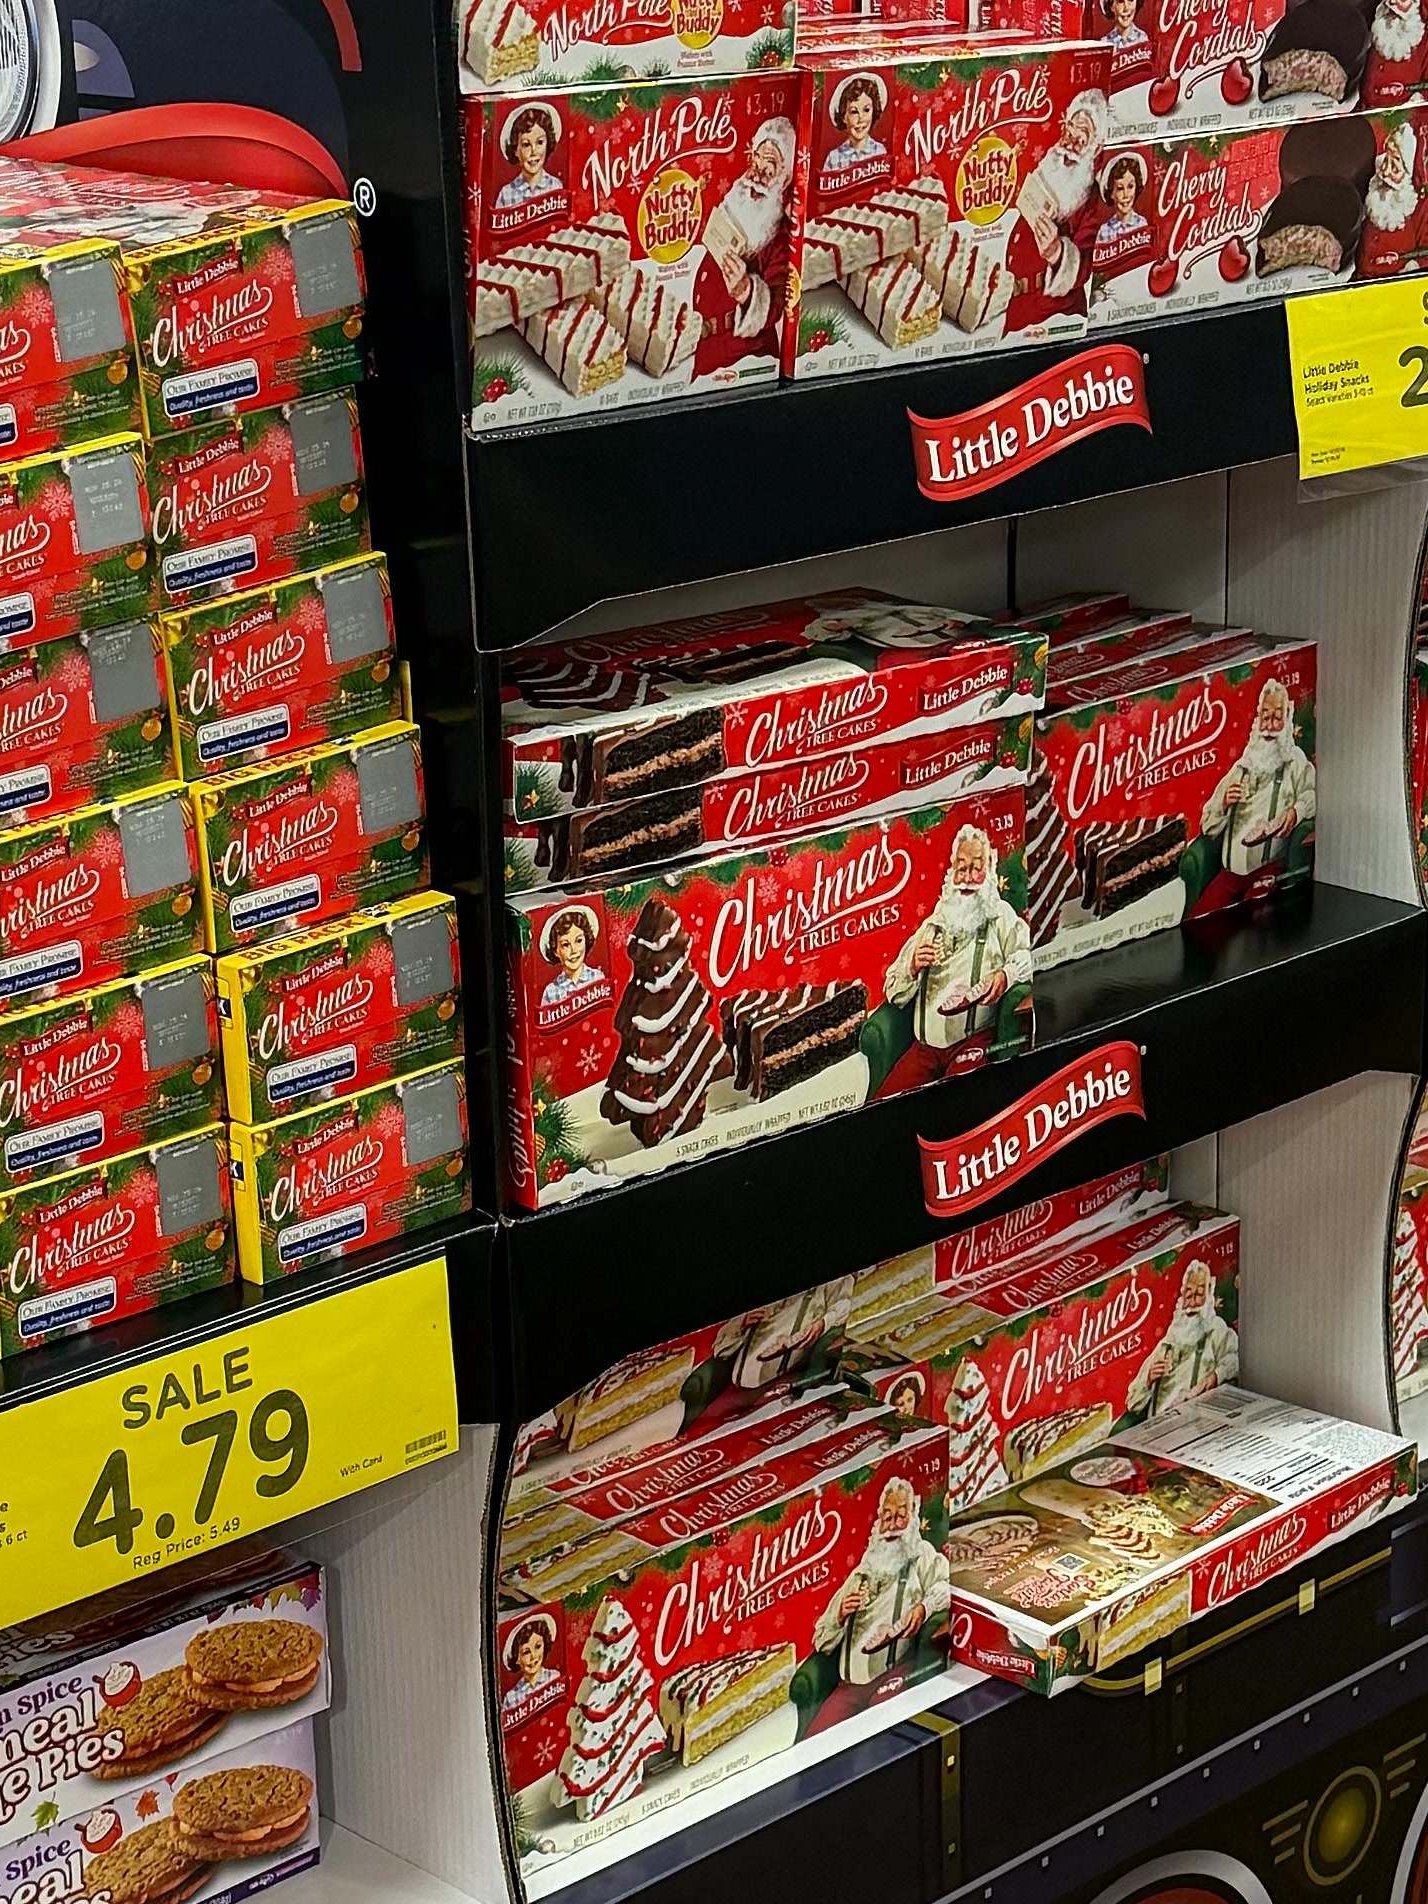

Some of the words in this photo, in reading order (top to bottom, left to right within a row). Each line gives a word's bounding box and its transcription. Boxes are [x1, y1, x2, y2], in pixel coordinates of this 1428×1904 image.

[583, 115, 673, 211] North
[665, 96, 738, 162] Pole
[491, 208, 525, 229] Little
[527, 195, 569, 221] Debbie
[645, 185, 703, 224] Nutty
[645, 213, 701, 250] Buddy
[1303, 366, 1326, 379] Little
[1329, 358, 1359, 374] Debbie
[1304, 379, 1338, 395] Holiday
[1340, 374, 1370, 388] Snacks
[924, 418, 1019, 485] Little
[1022, 369, 1135, 447] Debbie
[921, 681, 960, 712] Little
[962, 664, 1009, 699] Debbie
[744, 677, 889, 765] Christmas
[802, 730, 838, 753] TREE
[840, 716, 878, 744] CAKES
[707, 826, 912, 990] Christmas
[786, 922, 841, 966] TREE
[843, 902, 902, 941] CAKES
[538, 1003, 570, 1025] Little
[572, 983, 612, 1012] Debbie
[932, 1135, 1020, 1203] Little
[1025, 1066, 1133, 1156] Debbie
[1000, 1273, 1153, 1421] Christmas
[1056, 1361, 1100, 1394] TREE
[1100, 1332, 1143, 1373] CAKES
[120, 1346, 256, 1432] SALE
[70, 1387, 312, 1558] 4.79
[339, 1462, 360, 1479] With
[361, 1453, 383, 1472] Card
[5, 1532, 14, 1547] 6
[16, 1528, 28, 1543] ct
[132, 1549, 162, 1573] Reg
[165, 1531, 206, 1556] Price:
[209, 1516, 241, 1541] 5.49
[652, 1492, 842, 1671] Christmas
[724, 1594, 776, 1634] TREE
[776, 1562, 833, 1607] CAKES
[19, 1672, 84, 1717] Spice
[37, 1727, 127, 1805] Pies
[6, 1838, 71, 1882] Spice
